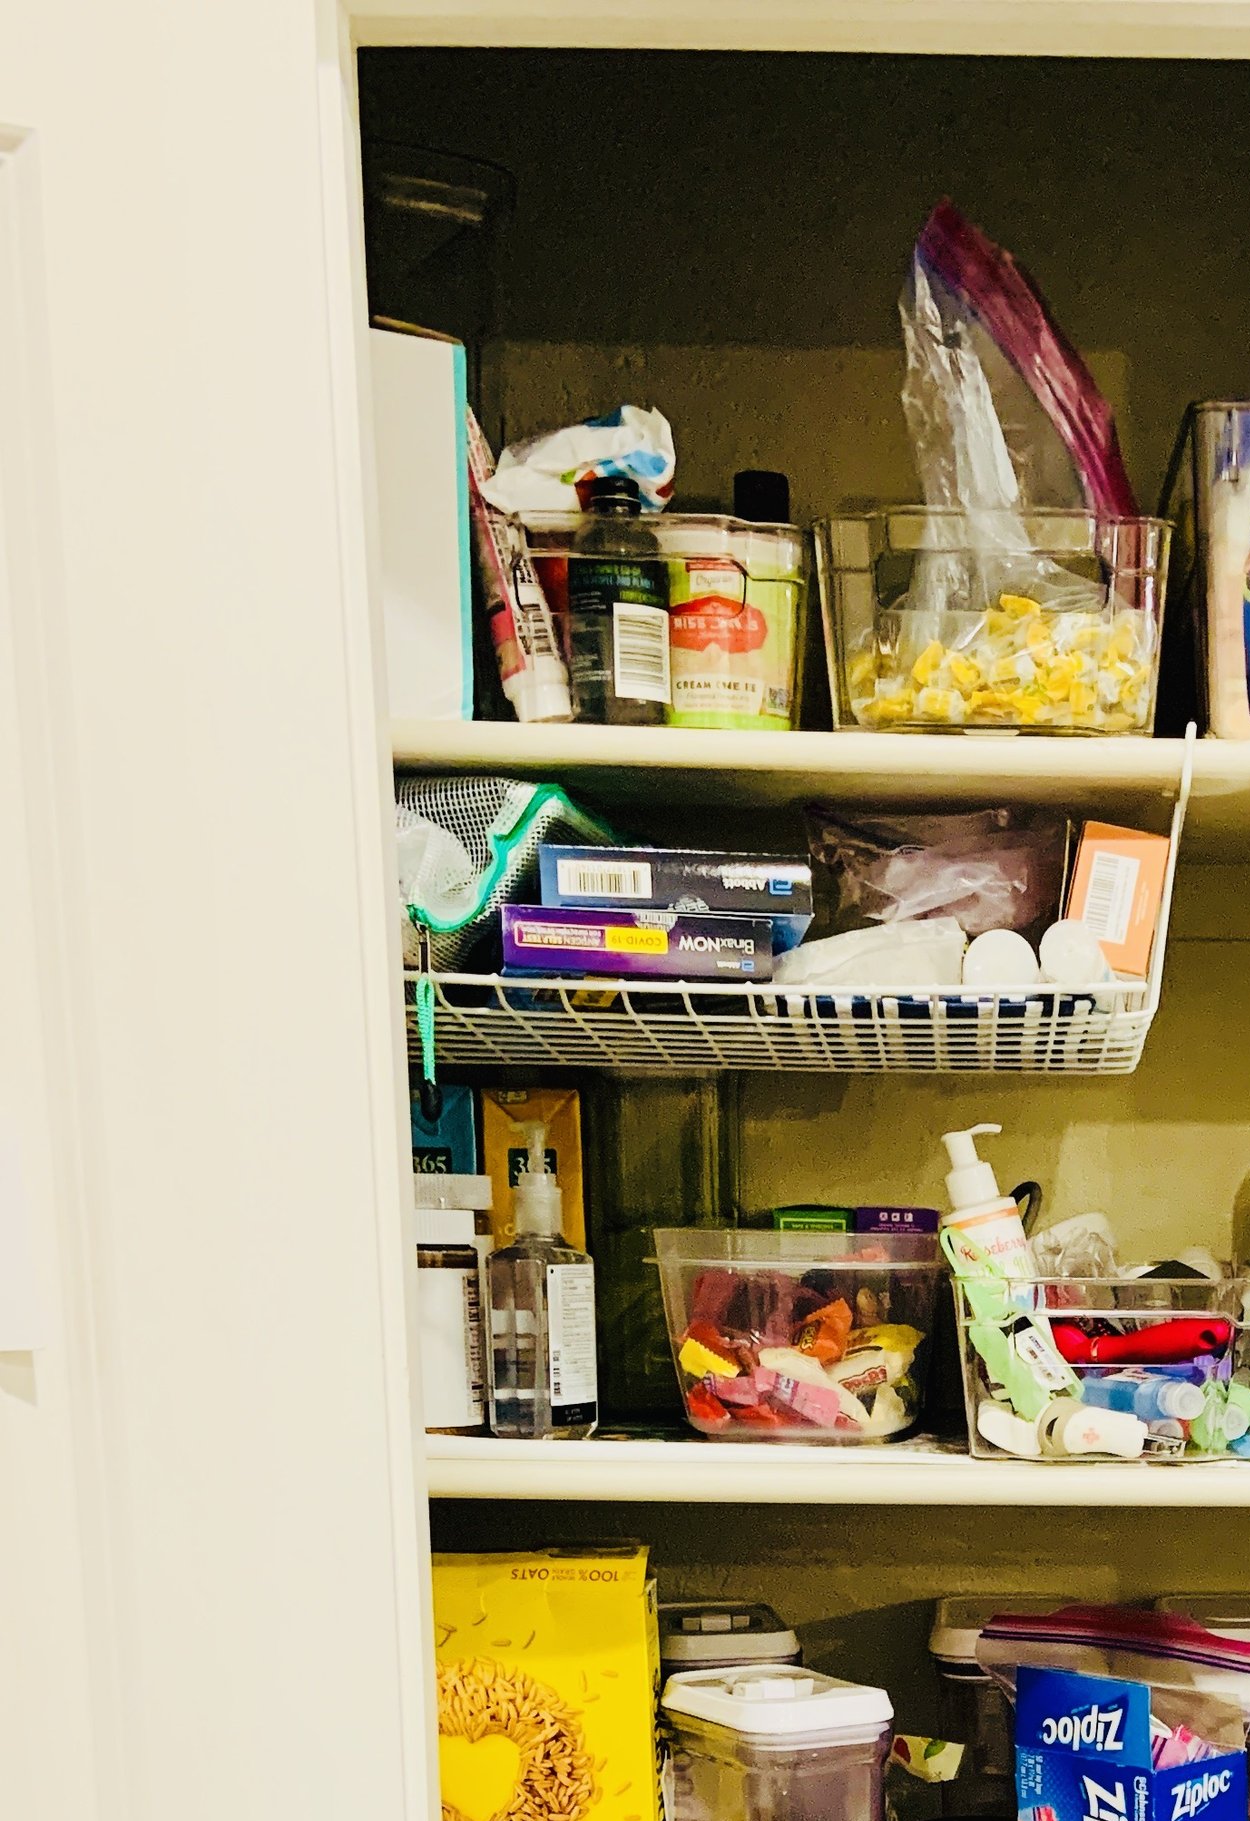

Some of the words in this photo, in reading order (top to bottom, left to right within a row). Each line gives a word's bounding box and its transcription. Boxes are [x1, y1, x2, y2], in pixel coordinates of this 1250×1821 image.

[722, 877, 766, 890] Abbott
[610, 933, 663, 946] COVID-19
[678, 935, 756, 955] BinaxNOW
[511, 1568, 550, 1581] OATS
[578, 1569, 619, 1582] 100%
[1042, 1704, 1124, 1752] Ziploc
